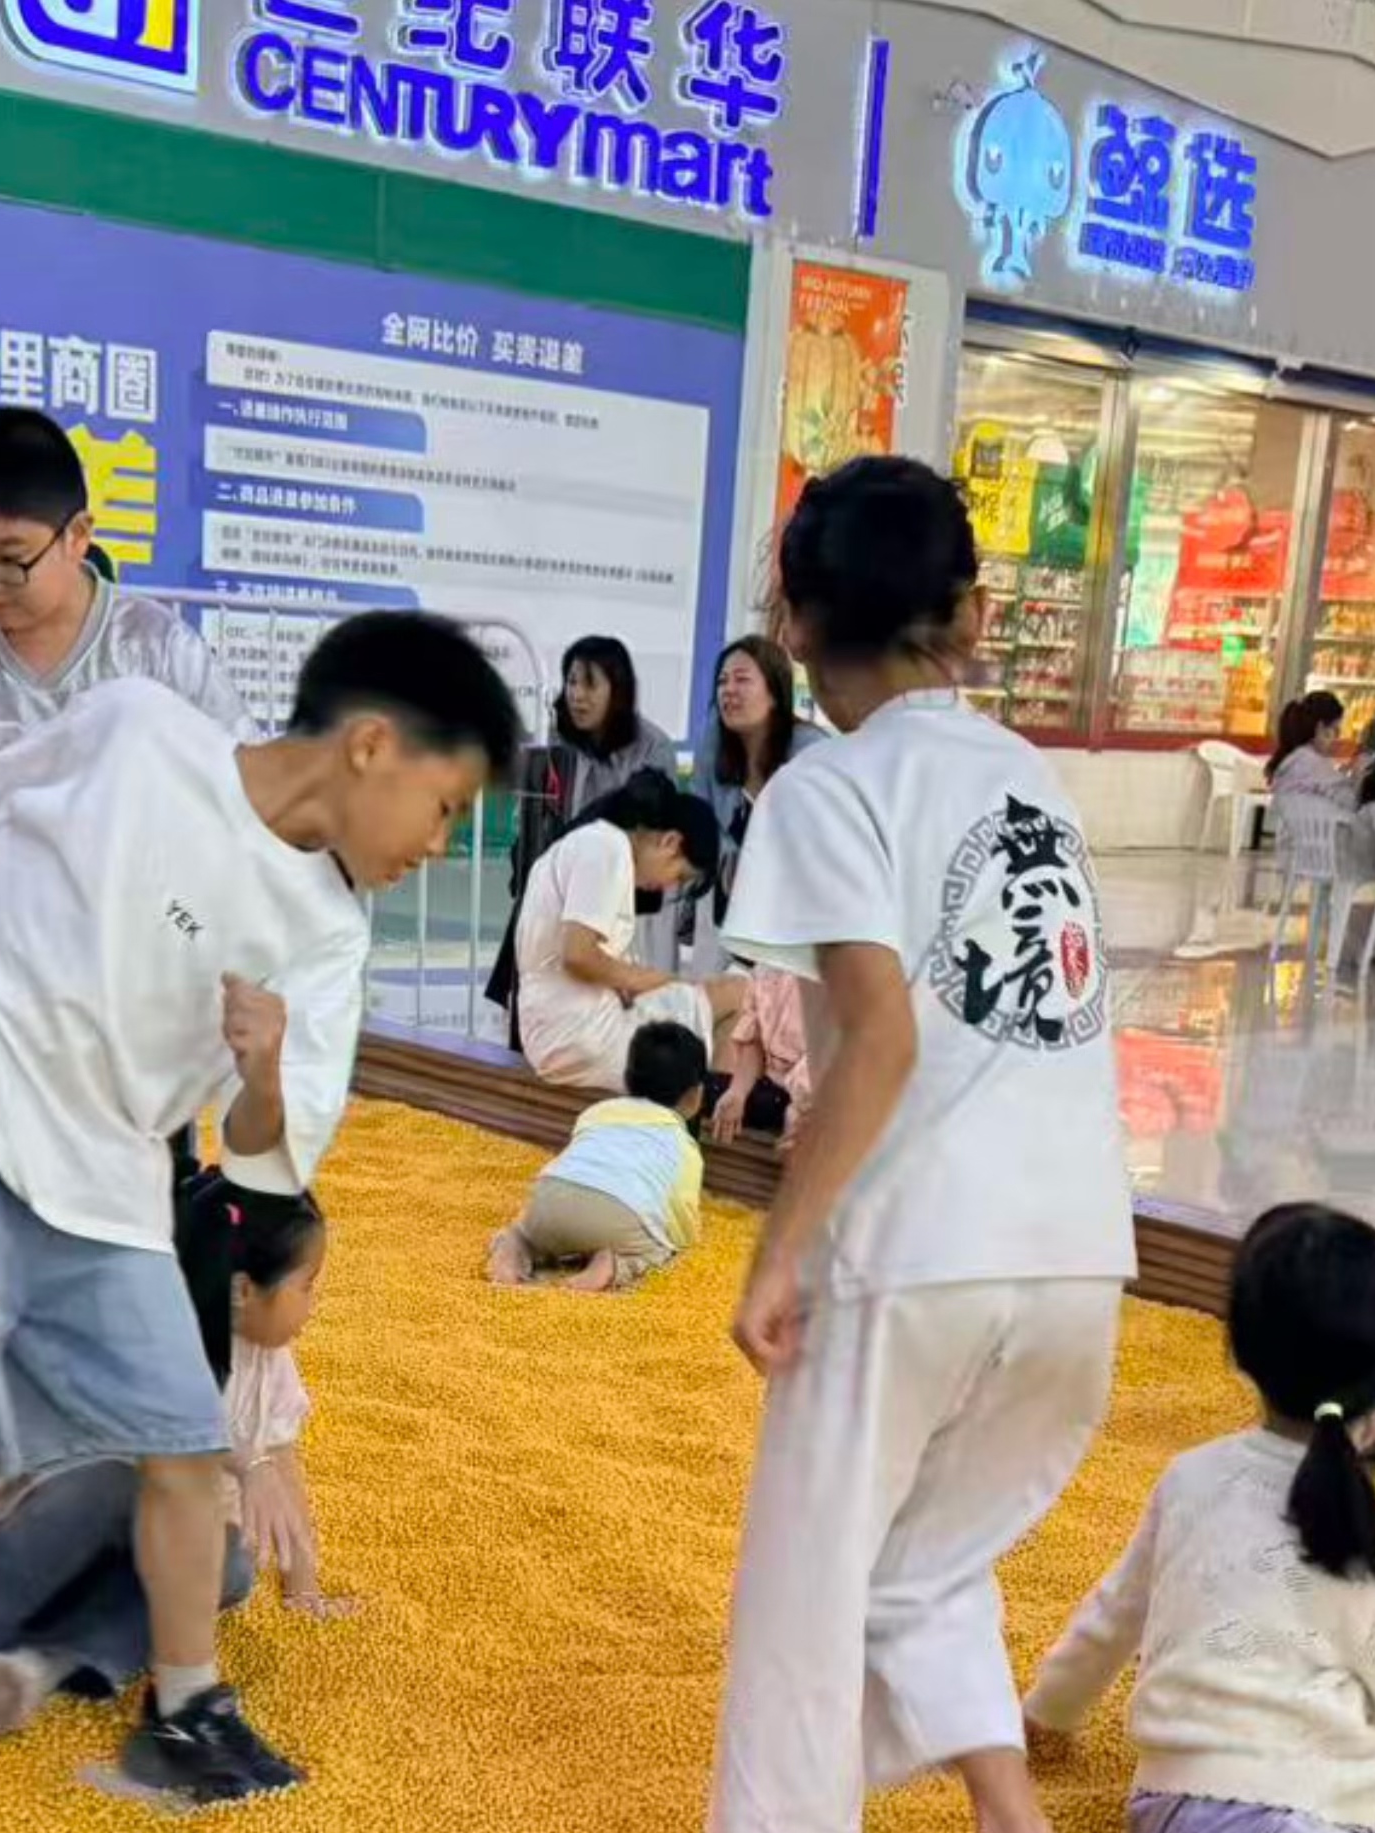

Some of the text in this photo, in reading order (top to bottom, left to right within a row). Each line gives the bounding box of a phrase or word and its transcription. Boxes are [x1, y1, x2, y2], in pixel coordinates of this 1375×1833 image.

[241, 32, 774, 217] CENTURYmart
[261, 0, 783, 128] 纪联华
[381, 311, 585, 376] 全网比价 买贵退差
